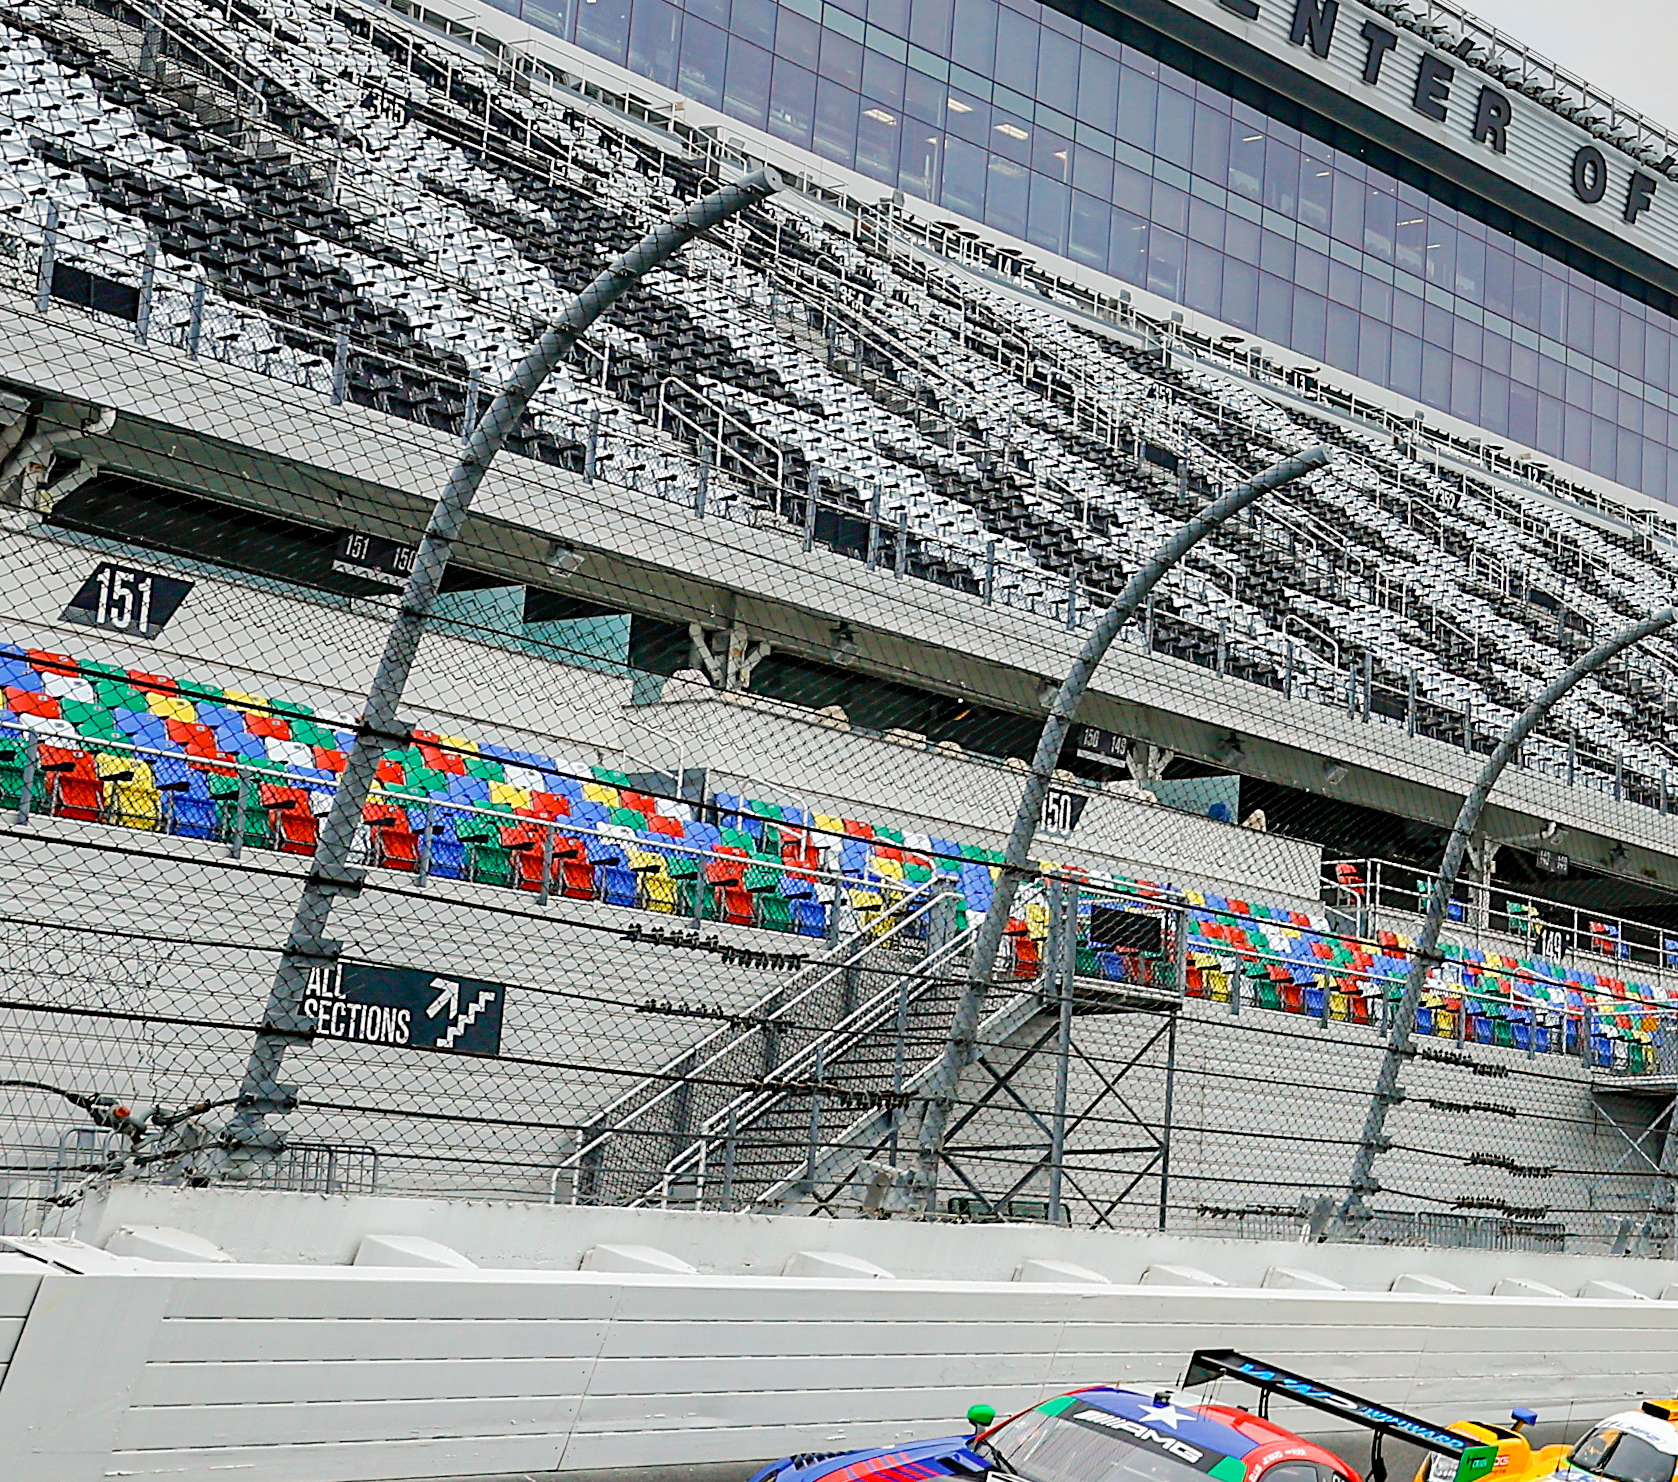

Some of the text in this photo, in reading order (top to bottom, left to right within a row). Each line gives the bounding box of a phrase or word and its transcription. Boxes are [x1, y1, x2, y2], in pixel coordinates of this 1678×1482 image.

[1574, 144, 1658, 226] OF
[345, 534, 369, 561] 151
[94, 563, 152, 635] 151
[1084, 728, 1128, 756] 150 149
[1541, 929, 1562, 964] 149
[307, 964, 347, 1003] ALL
[303, 1000, 411, 1046] SECTIONS
[1113, 1417, 1204, 1465] AMG
